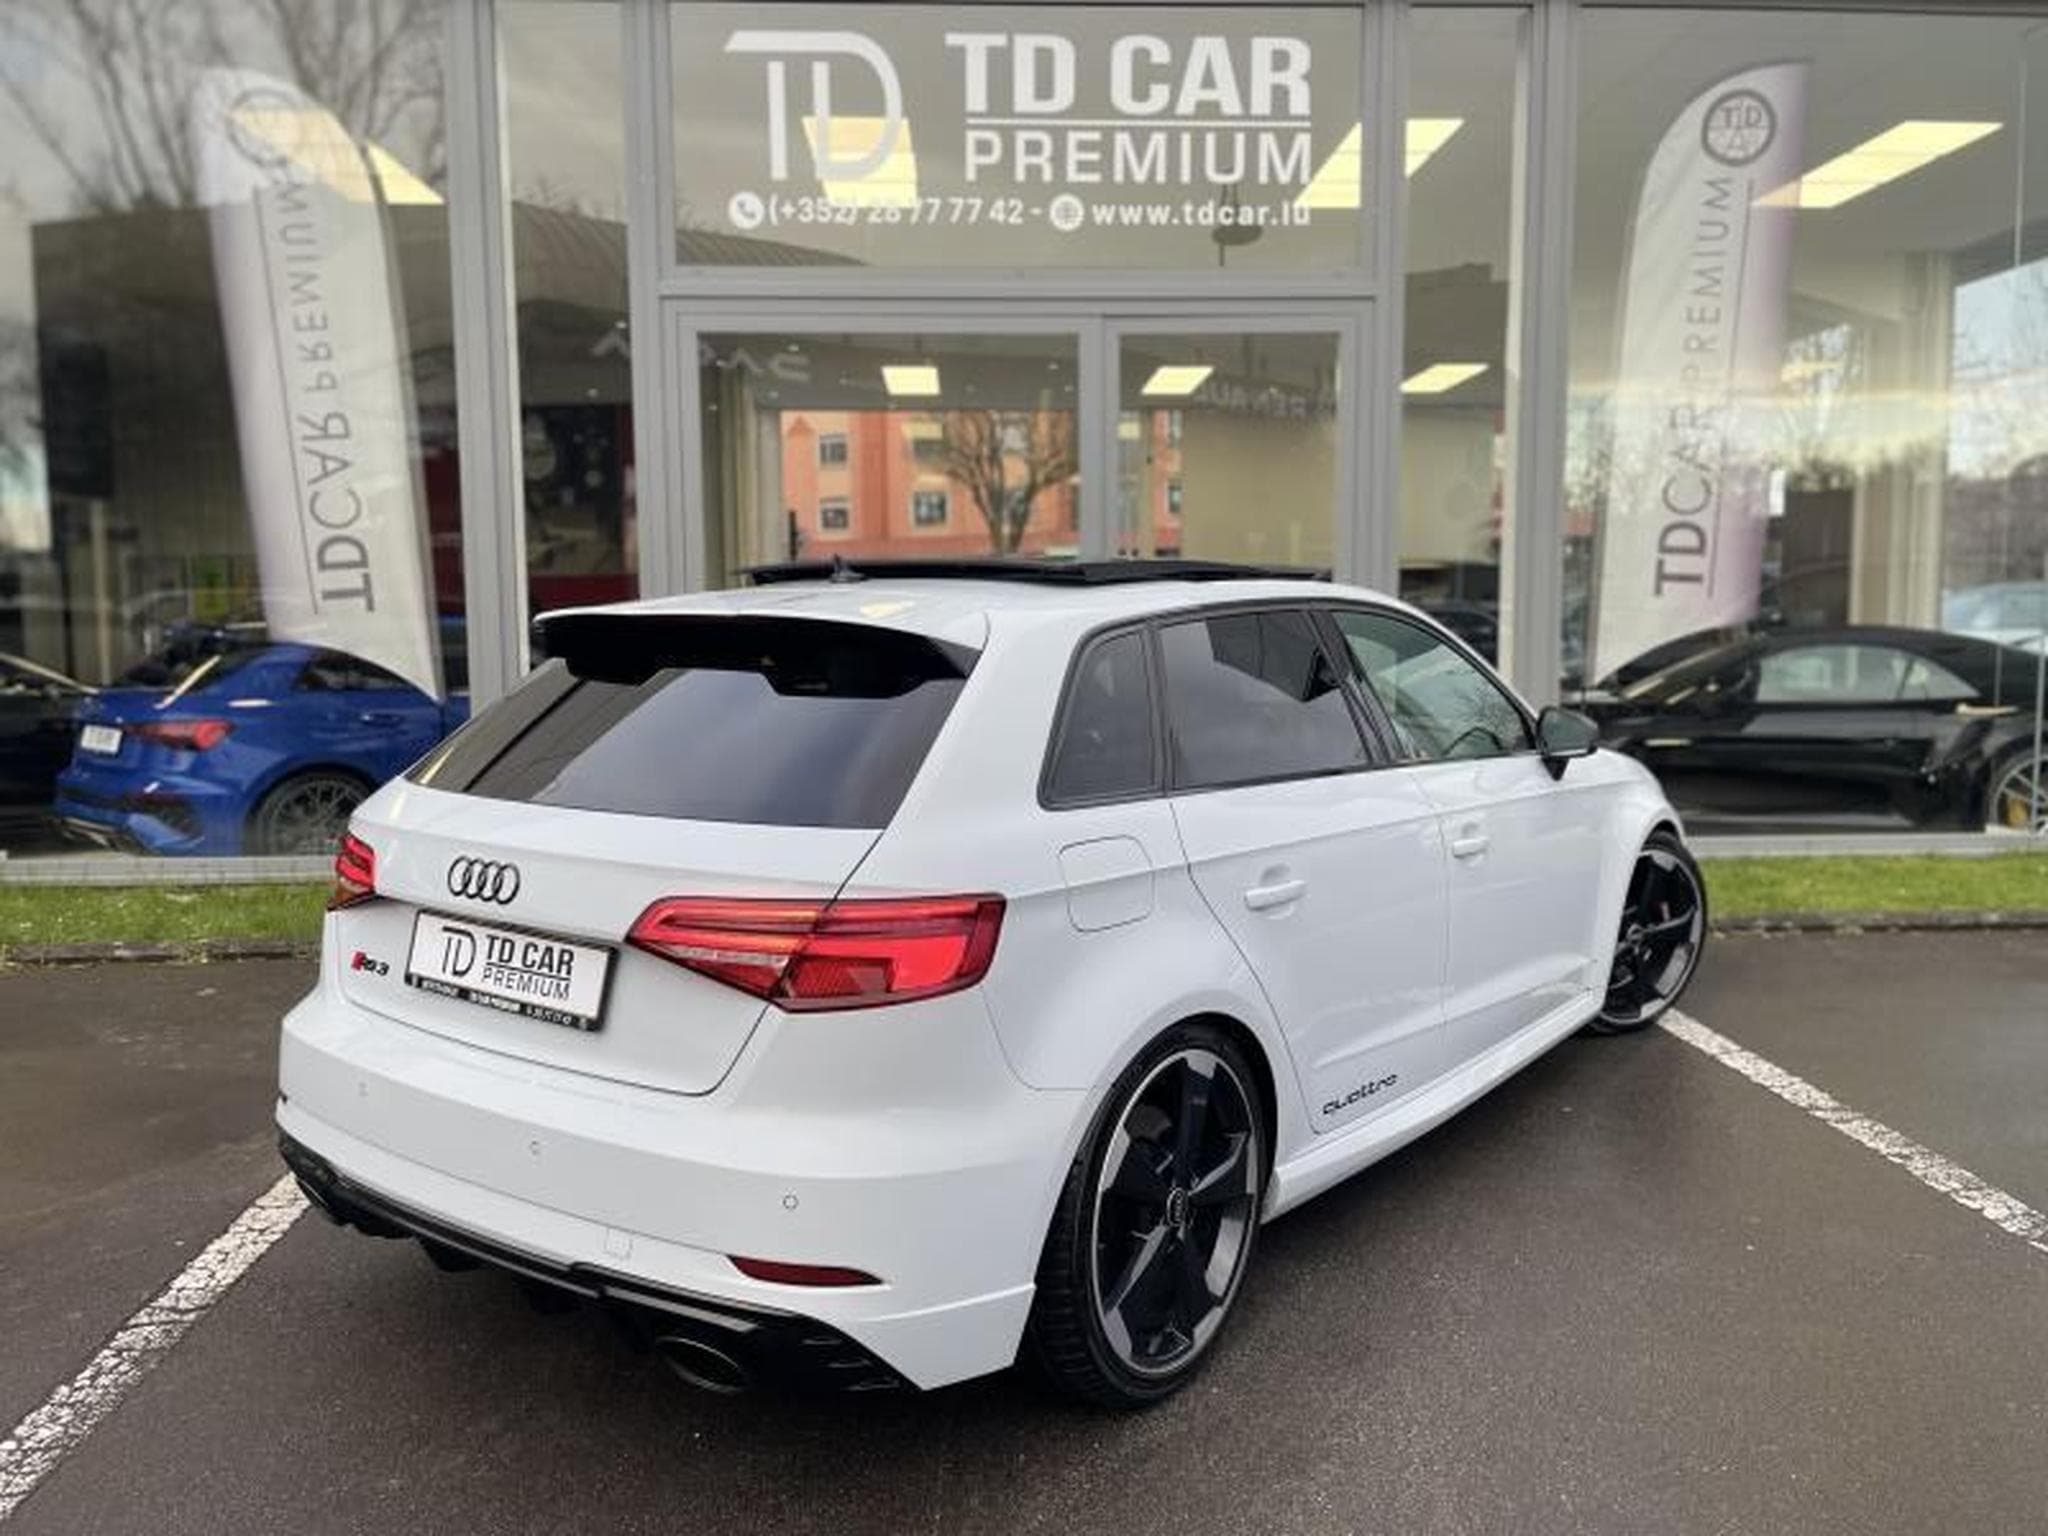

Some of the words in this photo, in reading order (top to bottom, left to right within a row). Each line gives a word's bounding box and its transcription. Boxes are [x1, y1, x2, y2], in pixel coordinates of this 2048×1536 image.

[945, 33, 1075, 115] TD
[1110, 35, 1312, 116] CAR
[964, 131, 1312, 185] PREMIUM
[949, 198, 982, 223] 77
[989, 198, 1023, 223] 42
[1092, 200, 1311, 226] www.tdcar.lu
[485, 934, 515, 963] TD
[522, 941, 574, 976] CAR
[482, 967, 570, 1000] PREMIUM
